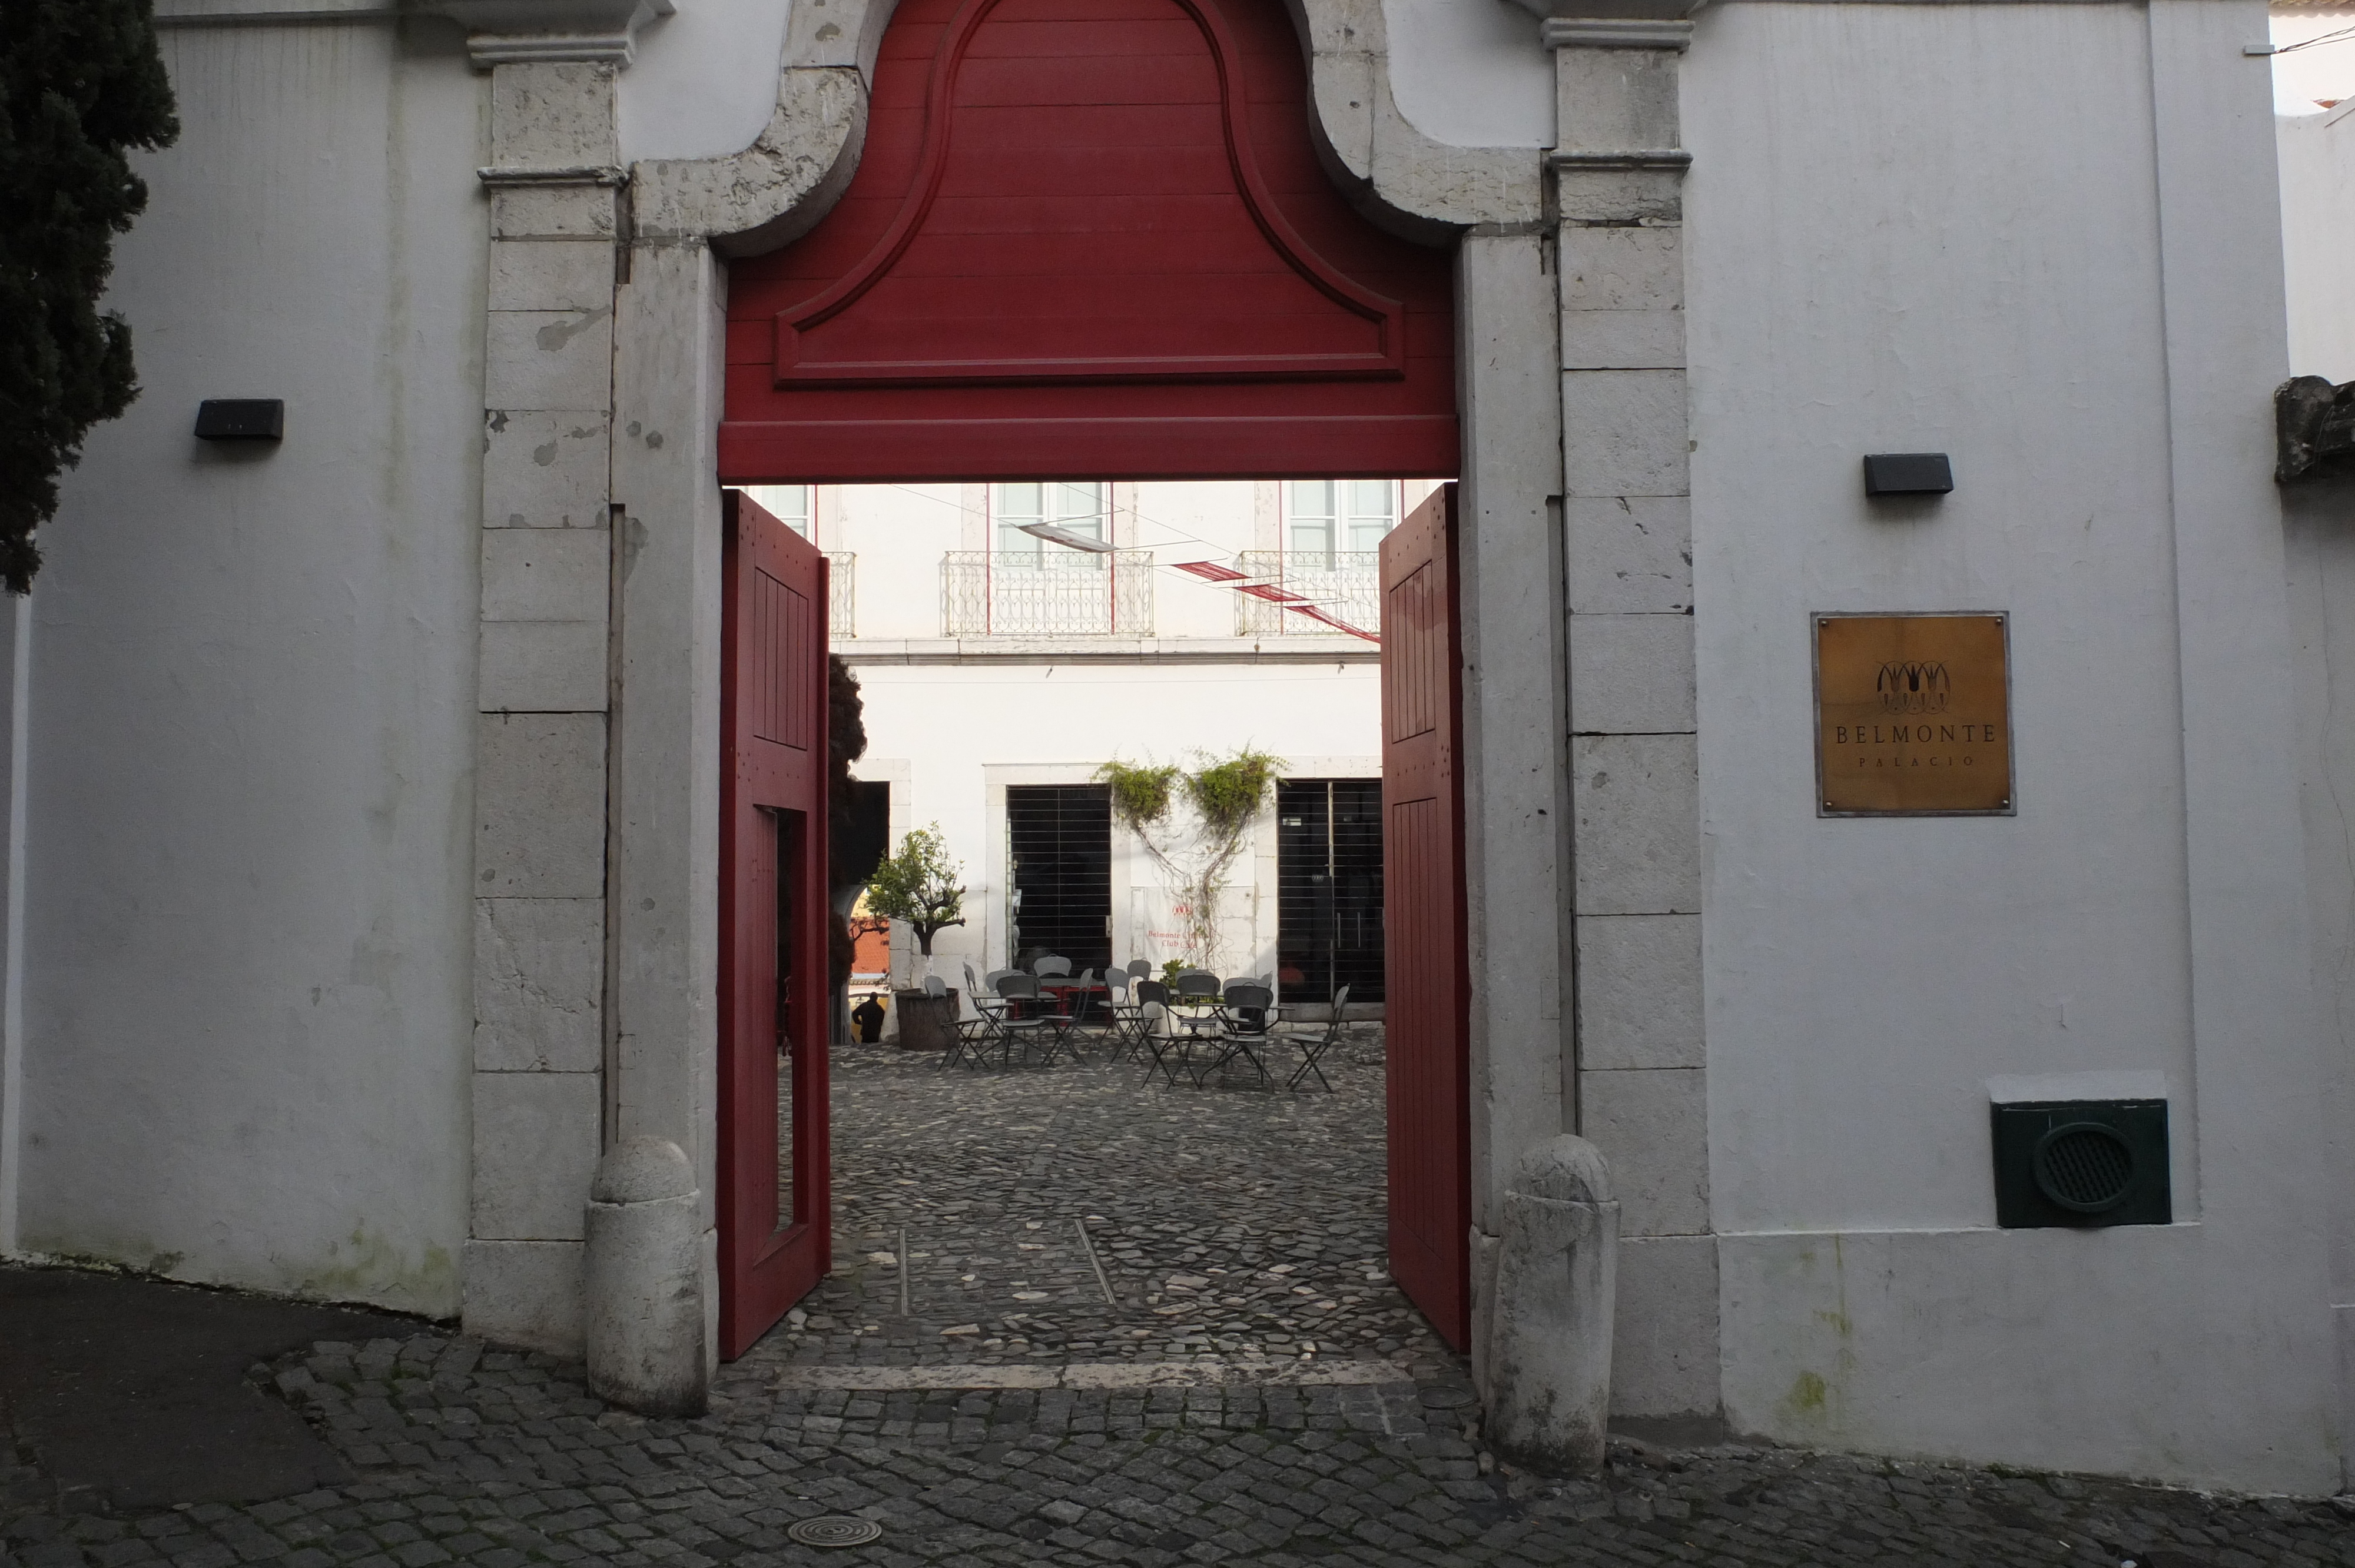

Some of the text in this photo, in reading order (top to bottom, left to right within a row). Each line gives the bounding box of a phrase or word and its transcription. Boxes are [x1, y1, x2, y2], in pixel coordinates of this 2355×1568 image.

[1836, 725, 1995, 743] BELMONTE
[1859, 756, 1973, 767] PALACIO
[1148, 930, 1181, 938] Belmonte
